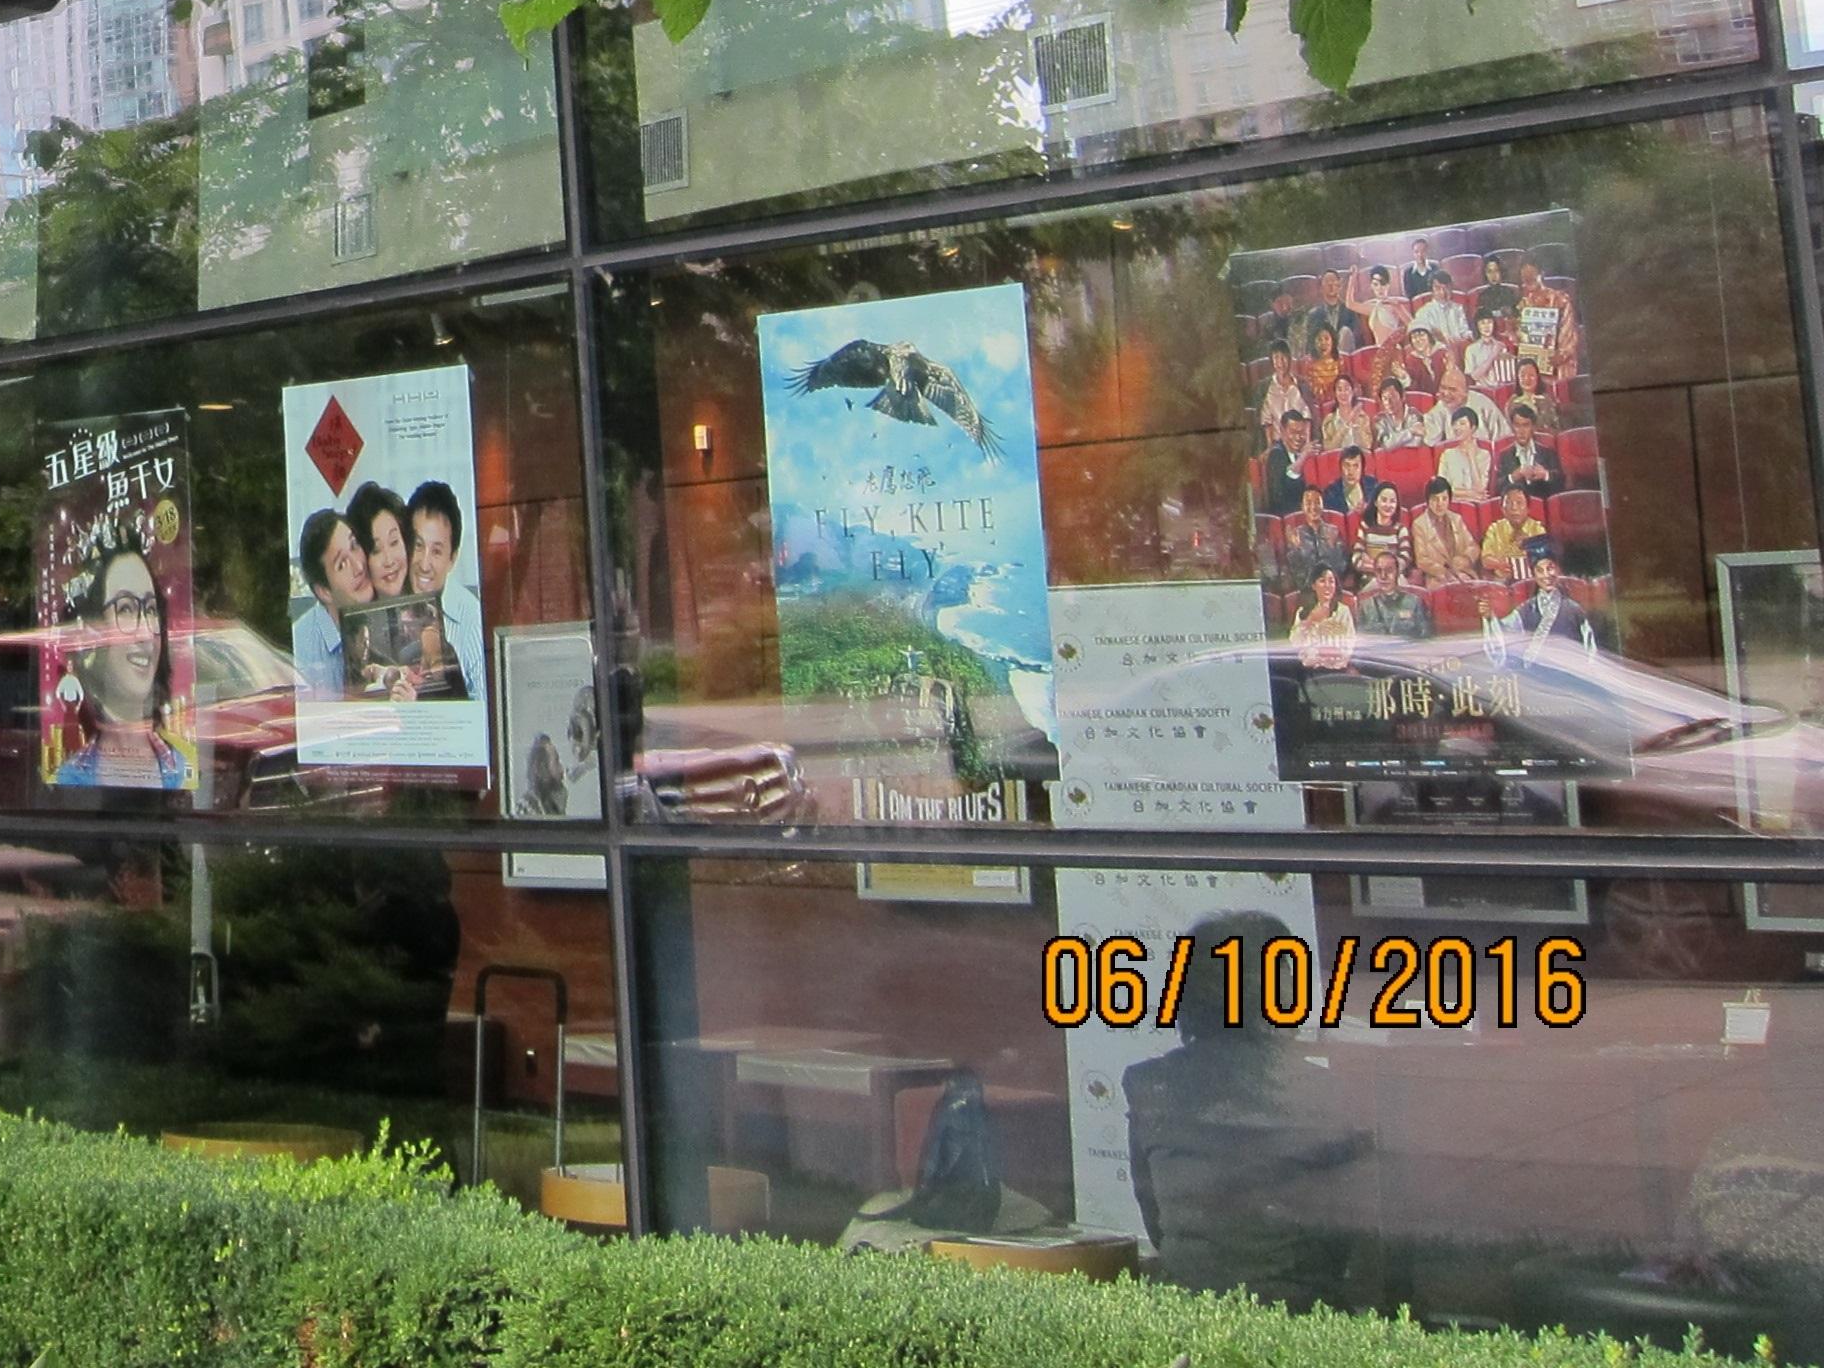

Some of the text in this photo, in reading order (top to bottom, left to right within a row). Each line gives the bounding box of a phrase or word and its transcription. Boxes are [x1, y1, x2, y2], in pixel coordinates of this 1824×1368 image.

[44, 429, 120, 490] 五星級
[908, 497, 994, 534] KITE
[870, 548, 937, 581] FLY
[1143, 634, 1186, 644] CANADIAN
[1188, 633, 1231, 643] CULTURAL
[1234, 632, 1266, 642] SOCIET
[1105, 708, 1147, 718] CANADIAN
[1150, 708, 1193, 718] CULTURAL
[1195, 707, 1231, 718] SOCIETY
[1104, 782, 1285, 793] TAIWANESE CANADIAN CULTURAL SOCIETY
[889, 789, 913, 820] AM
[1088, 1147, 1128, 1161] TAIWANES
